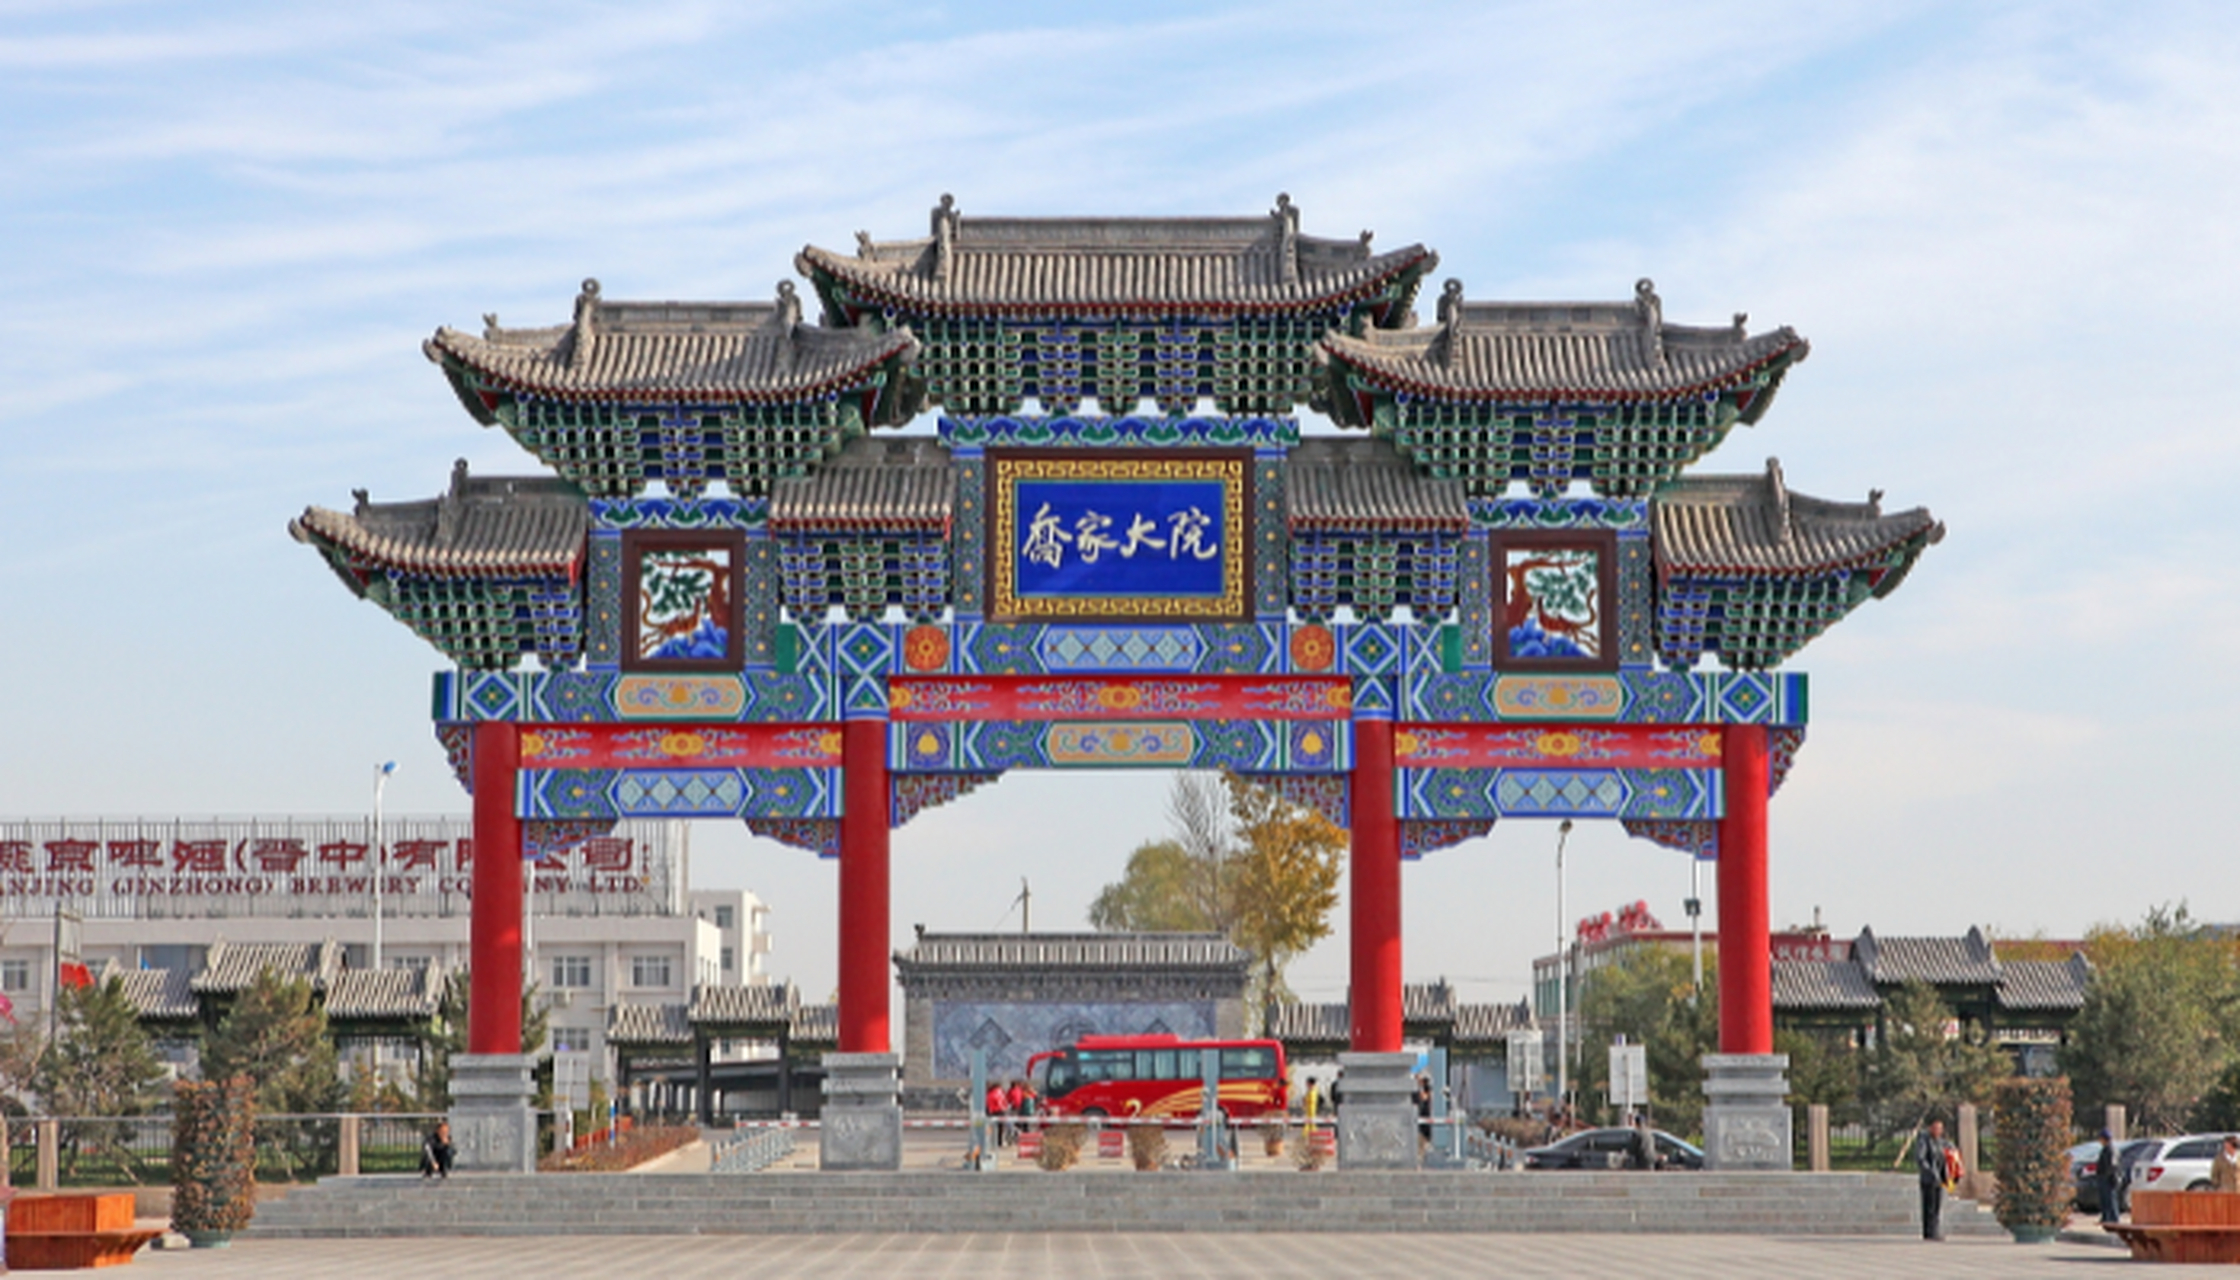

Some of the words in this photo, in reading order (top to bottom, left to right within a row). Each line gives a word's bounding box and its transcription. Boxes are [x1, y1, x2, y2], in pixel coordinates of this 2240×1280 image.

[1022, 502, 1217, 568] 喬家大院
[0, 877, 94, 896] NJING
[112, 876, 274, 896] (JINZHONG)
[438, 876, 570, 894] CONY
[589, 876, 645, 894] LTD.
